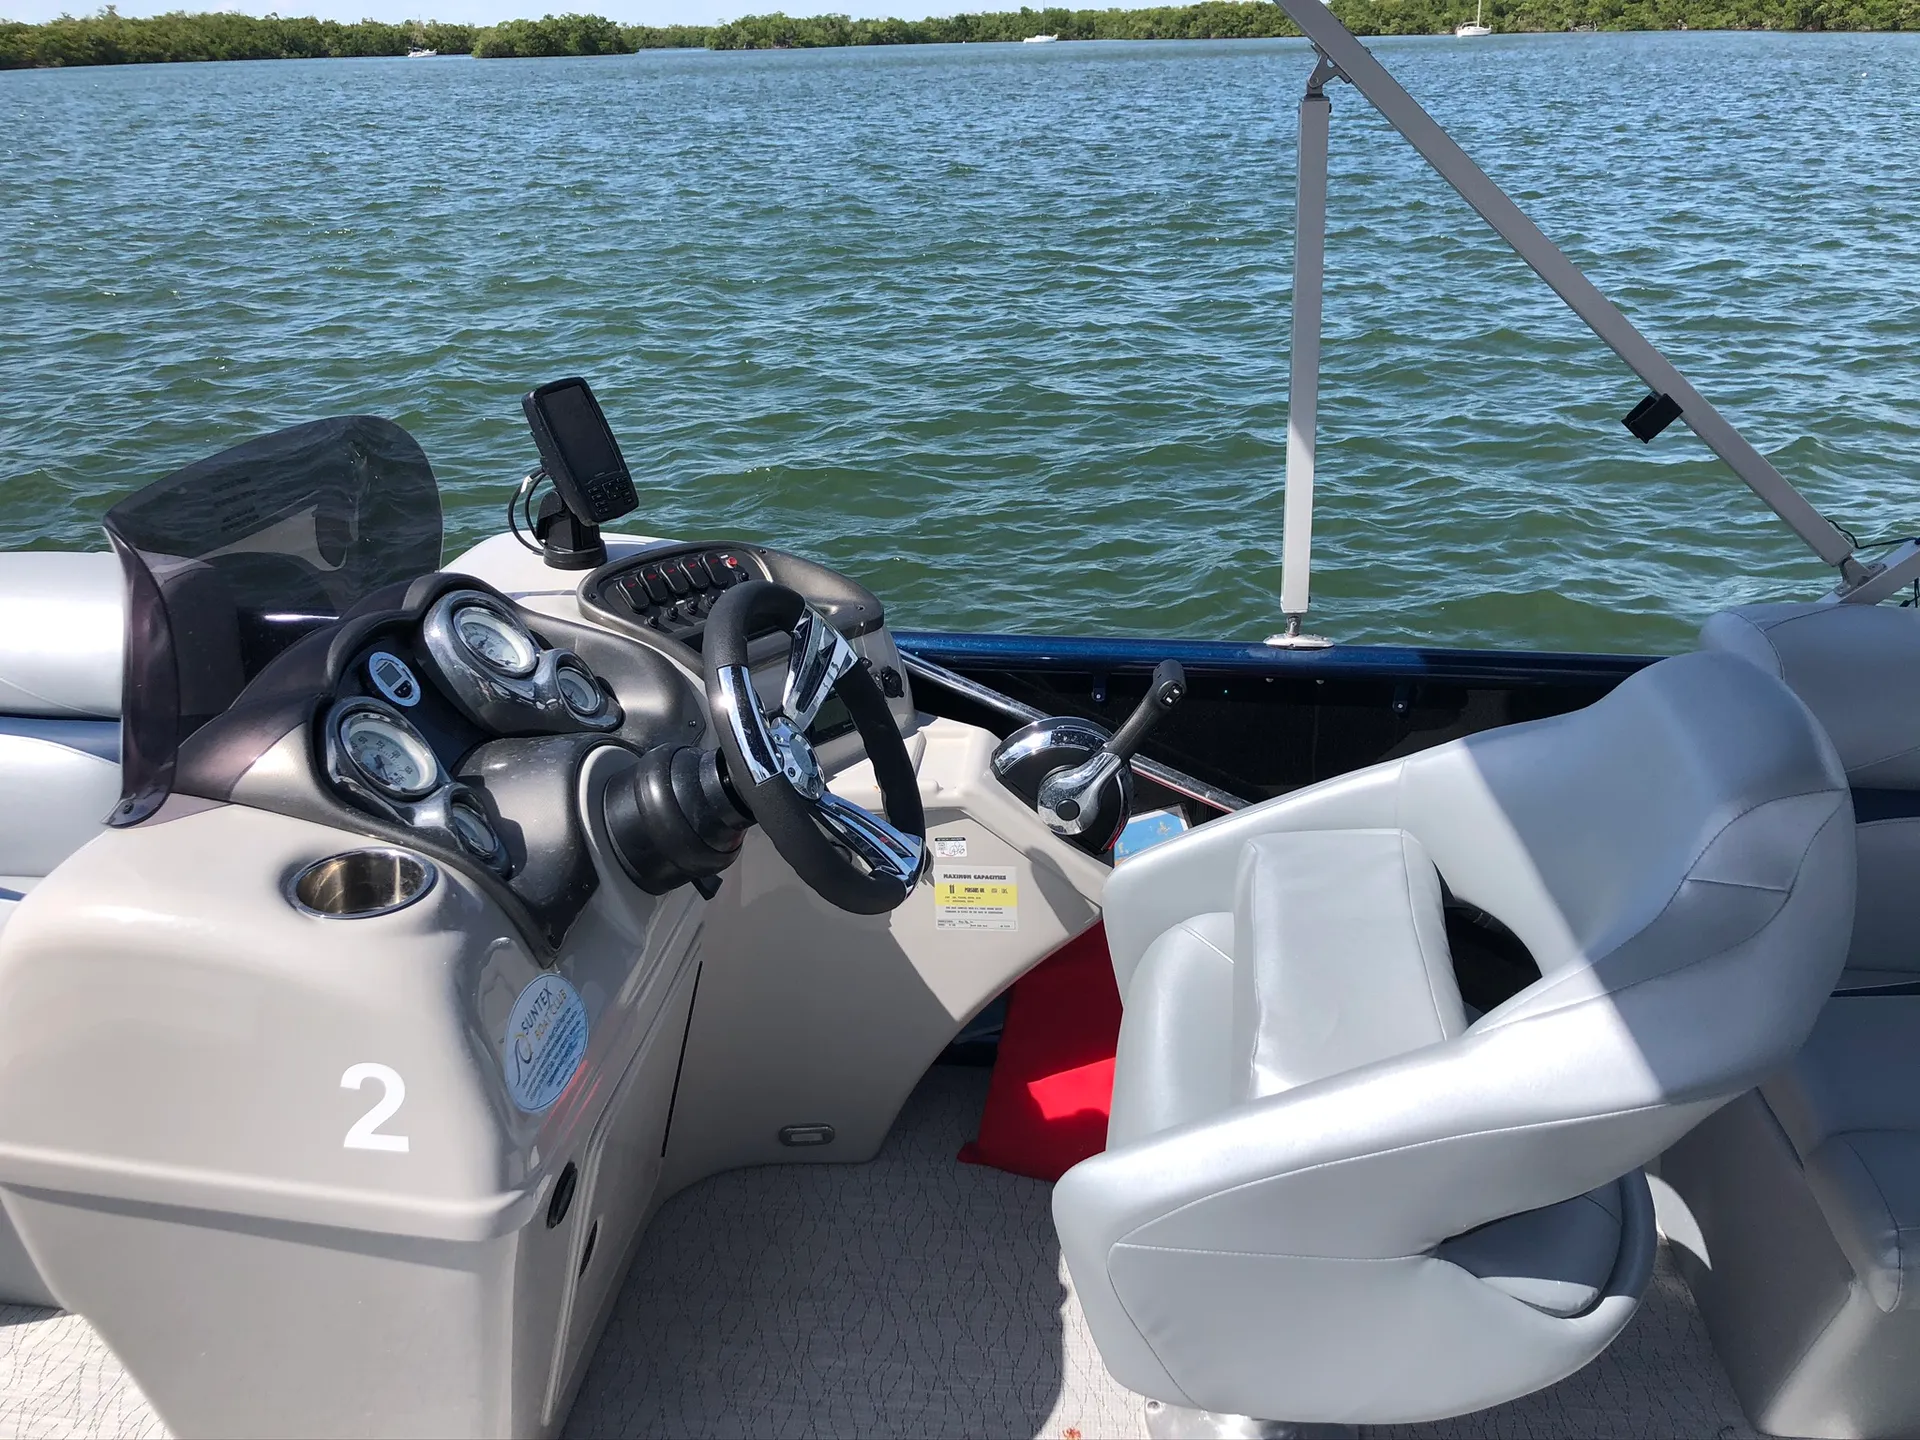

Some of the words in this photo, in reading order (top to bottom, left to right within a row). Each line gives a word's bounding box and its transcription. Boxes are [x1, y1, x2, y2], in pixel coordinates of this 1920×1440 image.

[521, 981, 553, 1036] SUNTEX
[534, 1011, 552, 1041] BOAT
[551, 988, 568, 1016] CLUB
[339, 1062, 410, 1153] 2
